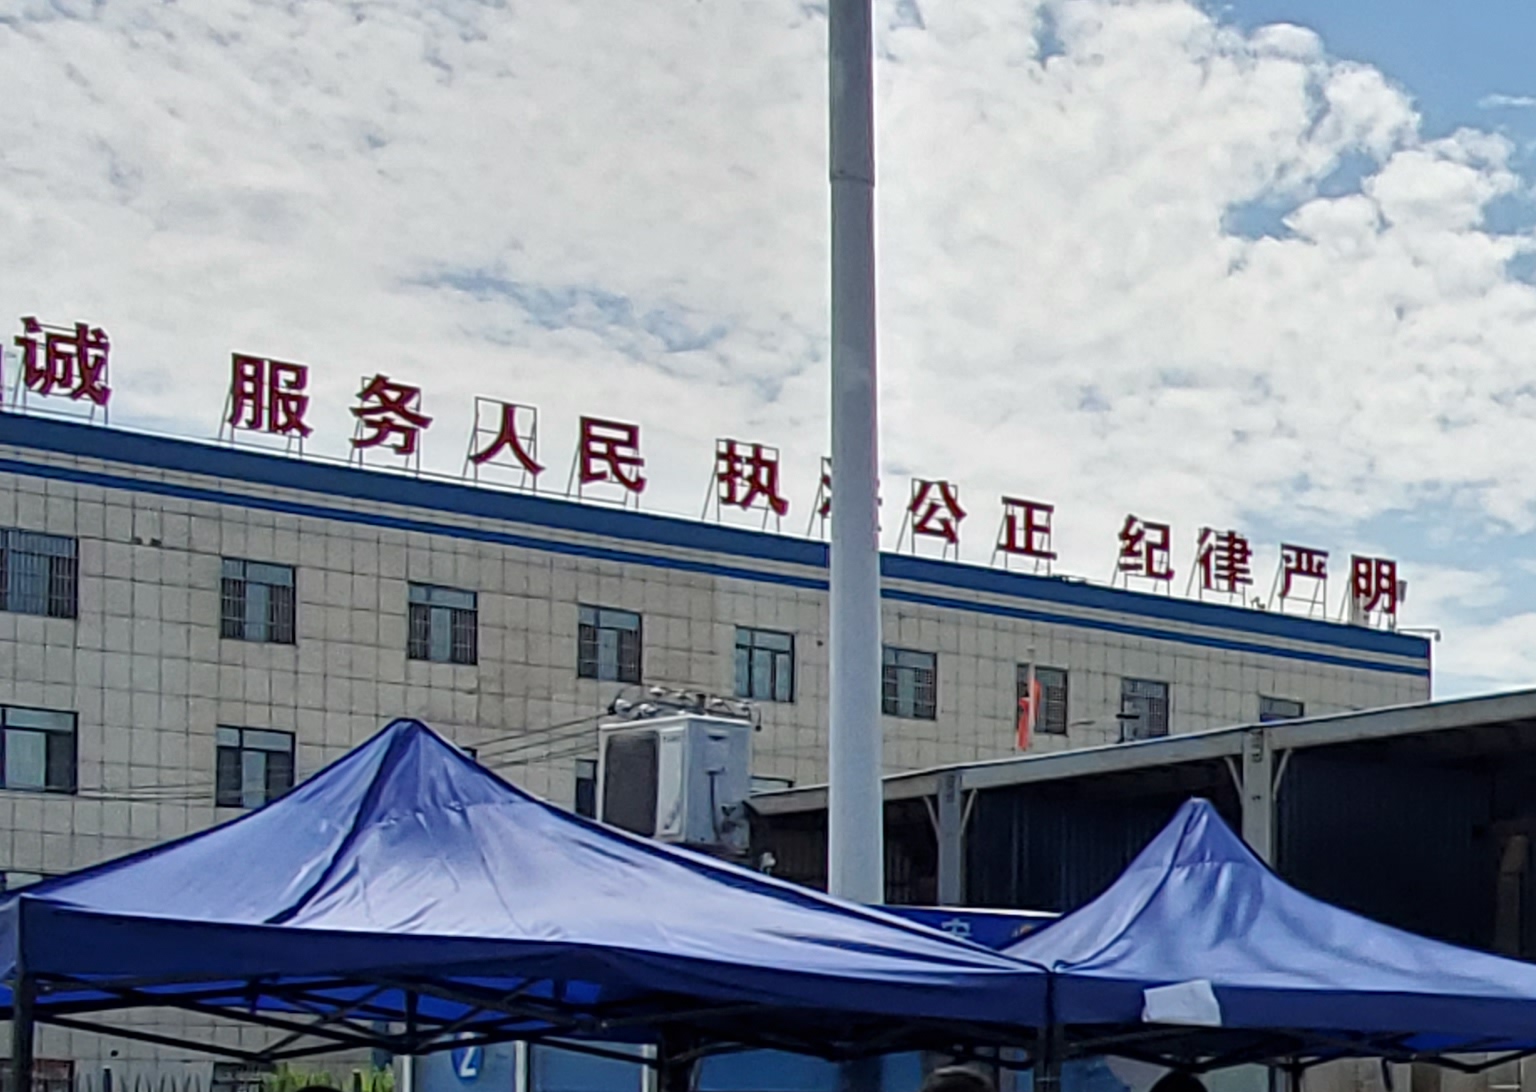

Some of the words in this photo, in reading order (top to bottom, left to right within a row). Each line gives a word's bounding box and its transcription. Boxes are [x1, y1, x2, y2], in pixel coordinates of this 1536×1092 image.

[227, 352, 647, 493] 服务人民
[716, 438, 1058, 560] 执公正
[1118, 514, 1398, 614] 纪律严明
